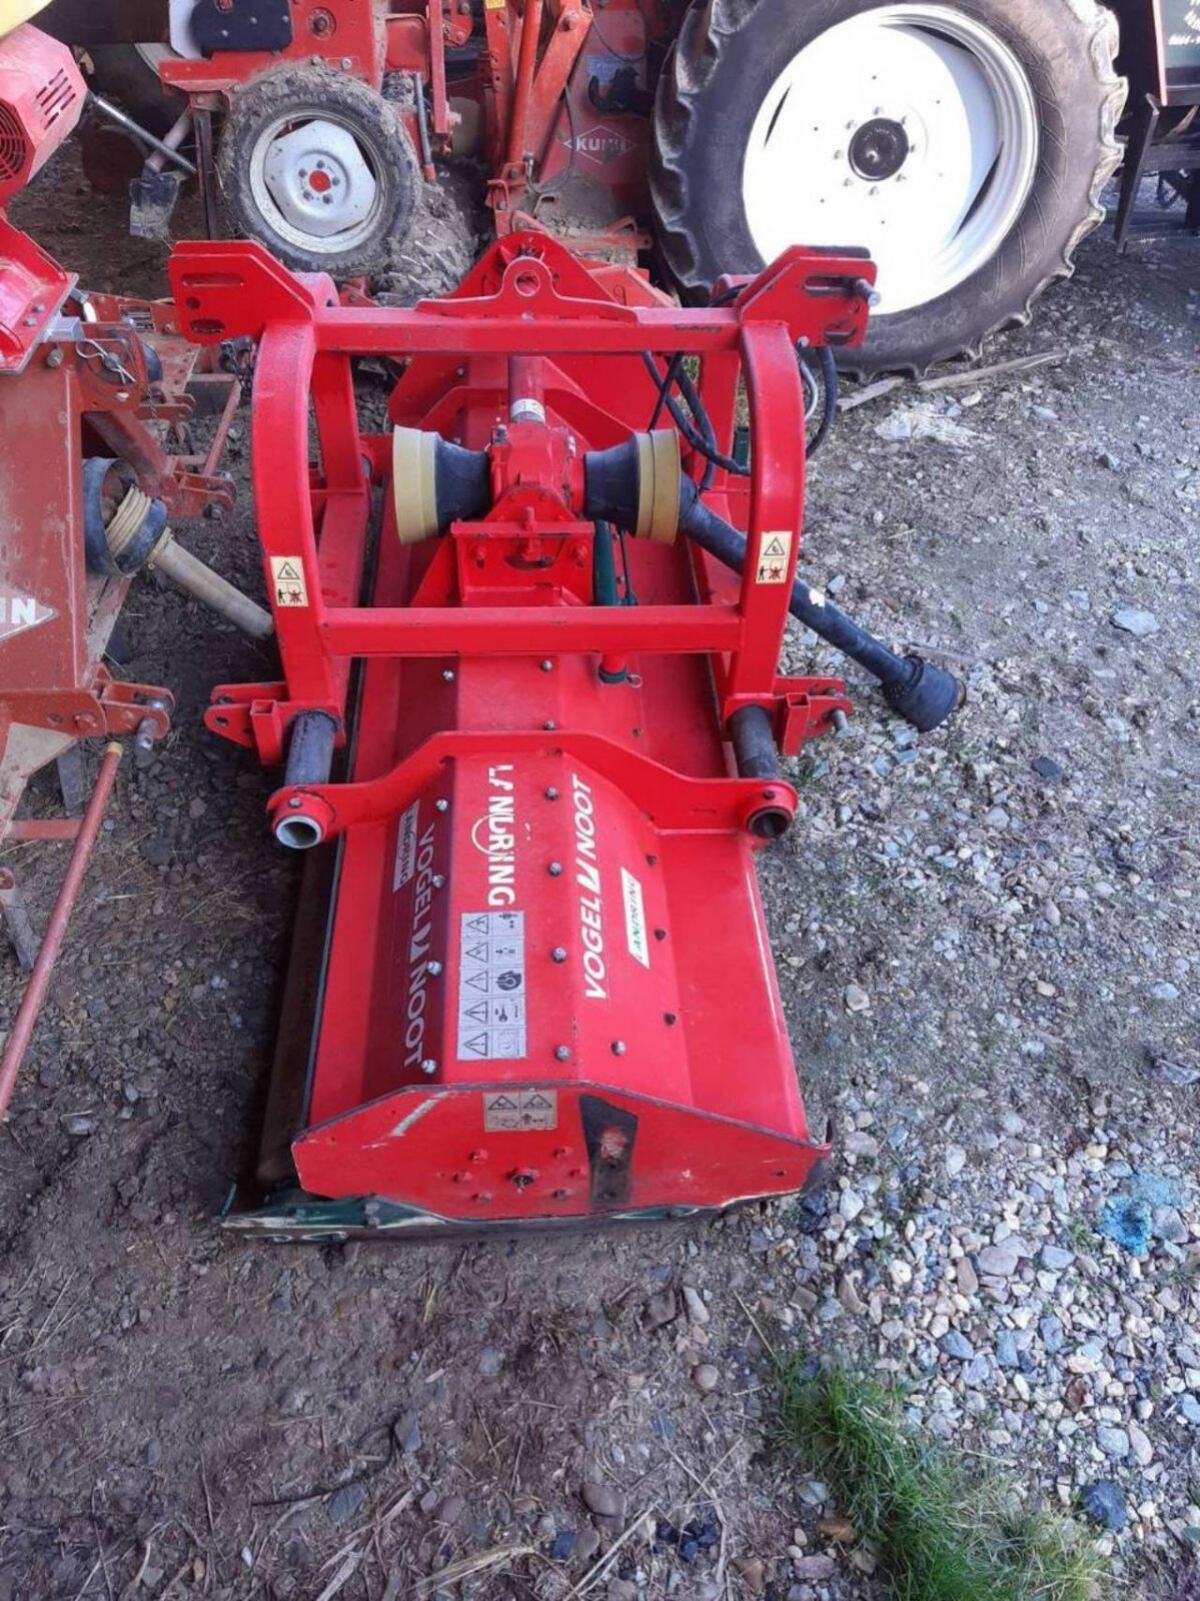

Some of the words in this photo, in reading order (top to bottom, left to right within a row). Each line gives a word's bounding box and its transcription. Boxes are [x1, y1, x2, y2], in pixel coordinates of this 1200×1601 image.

[572, 773, 597, 860] NOOT
[413, 822, 436, 931] VOGEL
[580, 896, 607, 999] VOGEL
[404, 960, 428, 1067] NOOT
